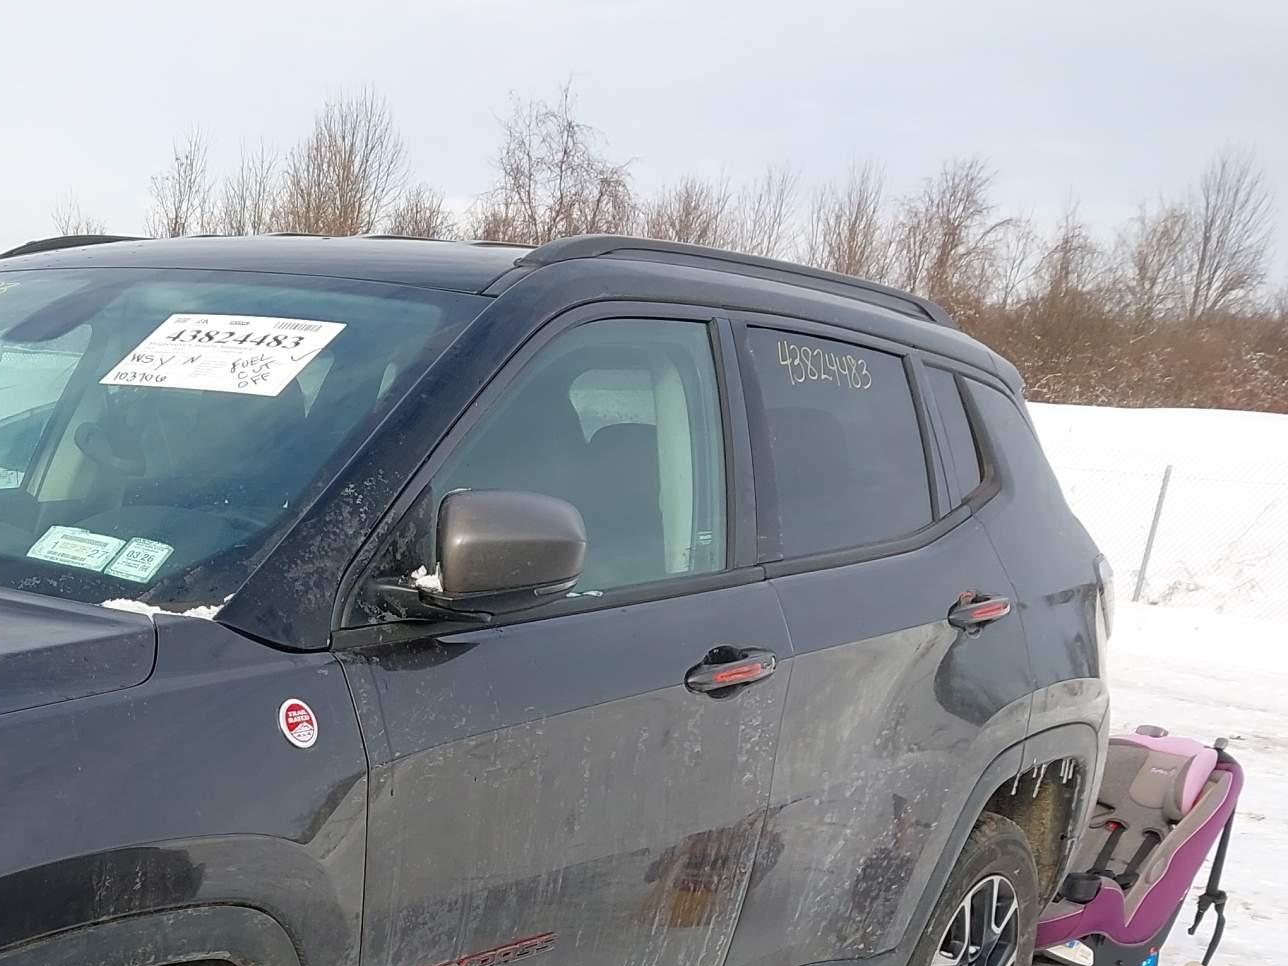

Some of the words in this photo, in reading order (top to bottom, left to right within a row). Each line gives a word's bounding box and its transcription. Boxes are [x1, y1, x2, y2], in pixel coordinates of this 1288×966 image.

[165, 328, 305, 349] 43824483
[230, 353, 273, 373] FUEL
[237, 359, 277, 380] CUT
[777, 340, 872, 389] 43824483
[237, 372, 272, 389] OFF
